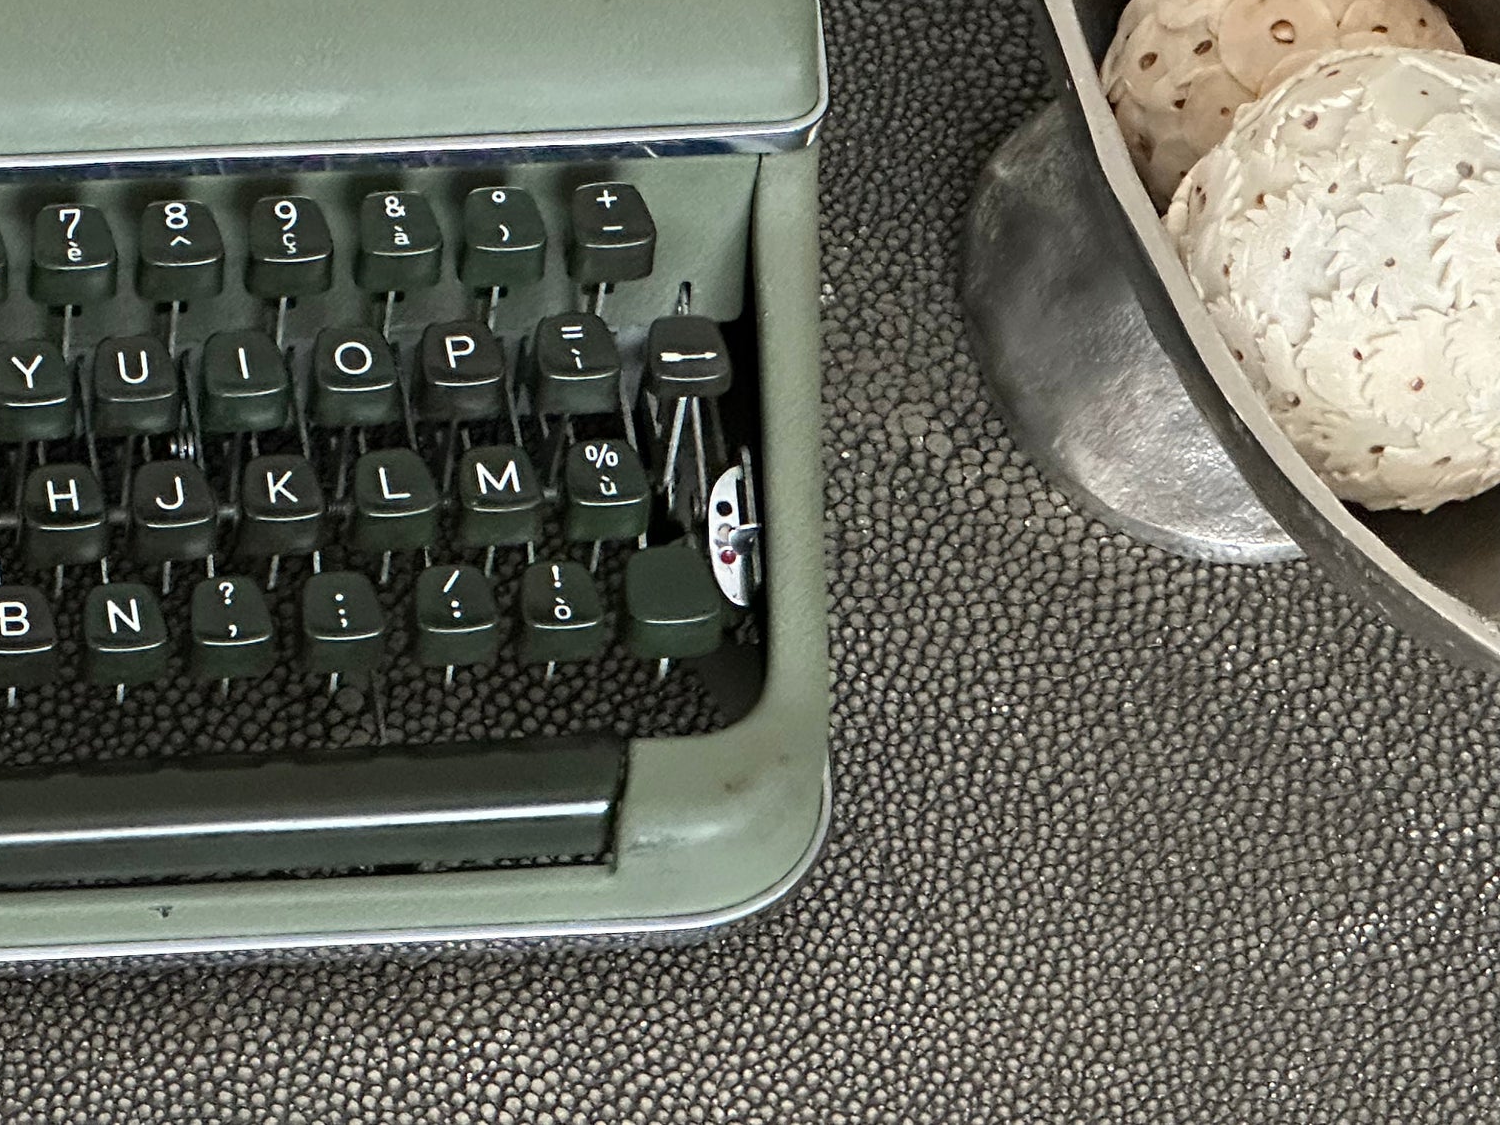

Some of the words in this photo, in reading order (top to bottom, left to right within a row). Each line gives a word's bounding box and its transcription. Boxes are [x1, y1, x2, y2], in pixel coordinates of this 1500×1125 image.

[59, 208, 81, 239] 7
[164, 202, 189, 230] 8
[274, 200, 298, 231] 9
[384, 195, 406, 218] &
[596, 189, 618, 209] +
[66, 241, 82, 262] è
[282, 232, 297, 254] ç
[393, 225, 411, 246] à
[11, 354, 43, 389] Y
[117, 350, 149, 384] U
[237, 347, 249, 380] I
[334, 341, 373, 375] O
[445, 335, 475, 369] P
[560, 325, 584, 339] =
[46, 478, 80, 513] H
[155, 476, 185, 510] J
[266, 470, 299, 504] K
[378, 466, 411, 500] L
[475, 460, 521, 495] M
[584, 443, 619, 469] %
[598, 475, 618, 496] ù
[106, 598, 141, 634] N
[218, 581, 235, 605] ?
[443, 569, 460, 593] /
[551, 564, 562, 588] !
[554, 597, 572, 620] ò
